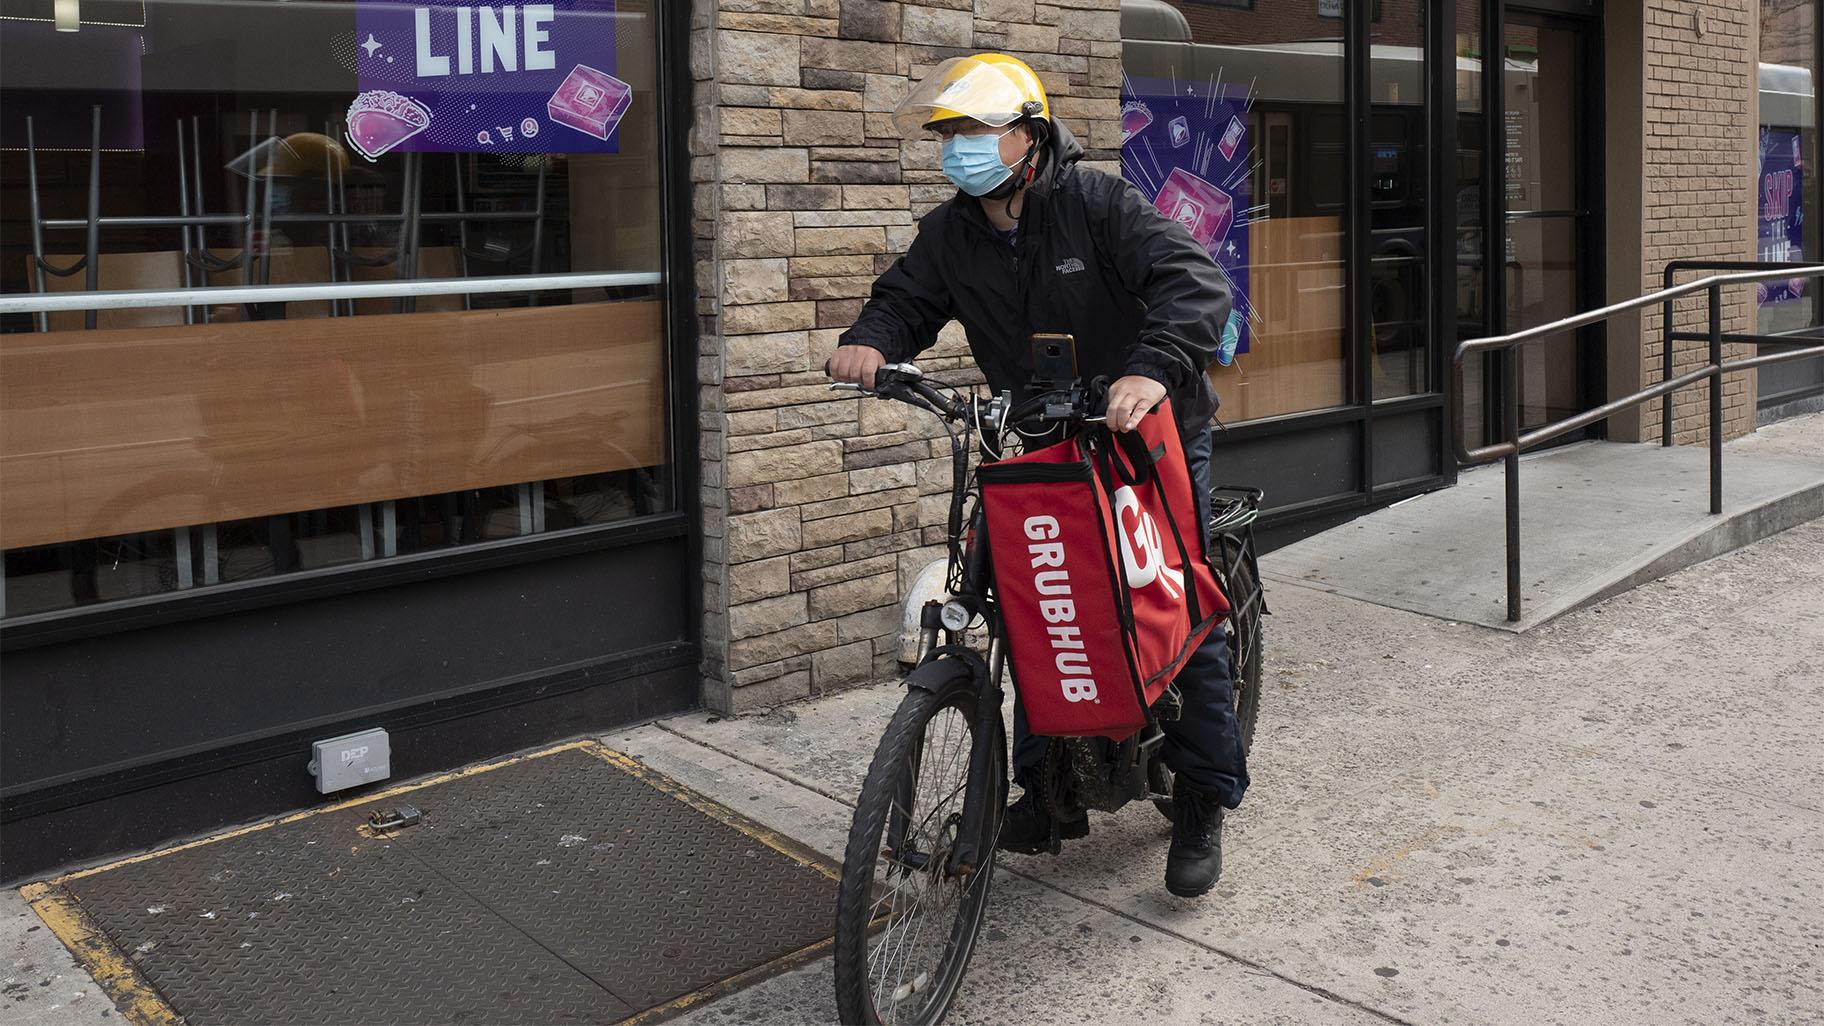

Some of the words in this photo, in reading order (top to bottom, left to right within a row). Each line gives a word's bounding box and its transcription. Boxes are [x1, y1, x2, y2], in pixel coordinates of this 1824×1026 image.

[414, 4, 556, 77] LINE
[1764, 169, 1793, 222] SKIP
[1770, 219, 1786, 241] THE
[1765, 240, 1792, 262] LINE
[1056, 263, 1075, 271] NORTH
[1062, 267, 1076, 275] FACE
[1023, 514, 1099, 704] GRUBHUB
[341, 746, 369, 762] DEP
